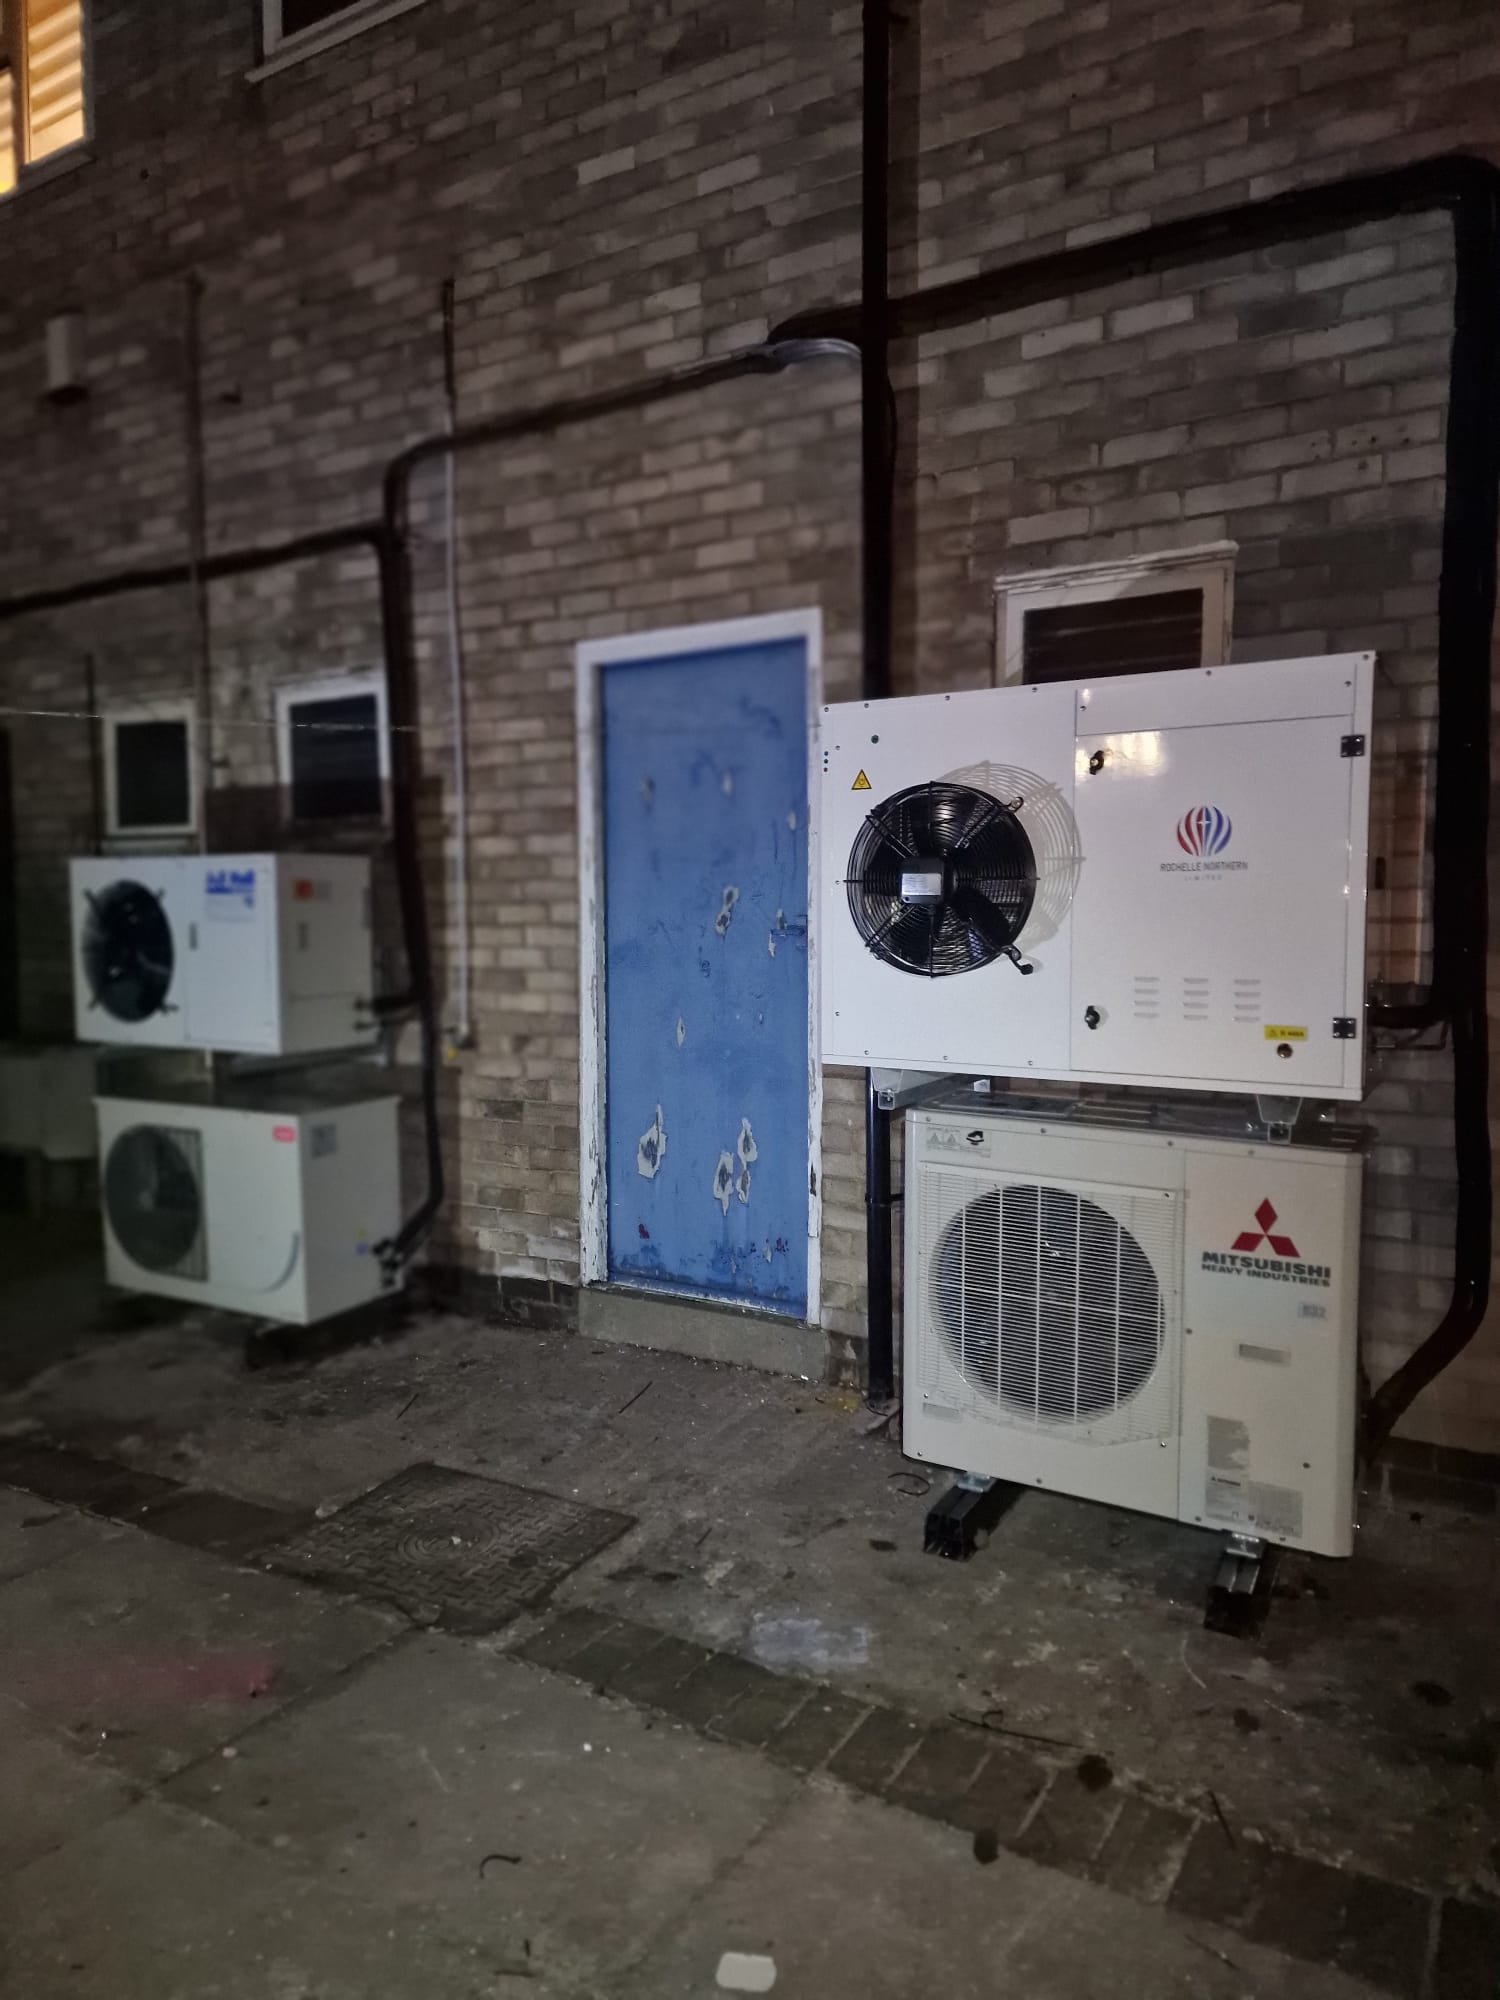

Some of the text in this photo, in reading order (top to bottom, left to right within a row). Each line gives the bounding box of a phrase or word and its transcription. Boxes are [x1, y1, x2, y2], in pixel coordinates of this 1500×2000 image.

[1160, 860, 1249, 872] ROCHELLE NORTHERN
[1201, 1263, 1331, 1287] HEAVY INDUSTRIES
[1202, 1251, 1331, 1279] MITSUBISHI
